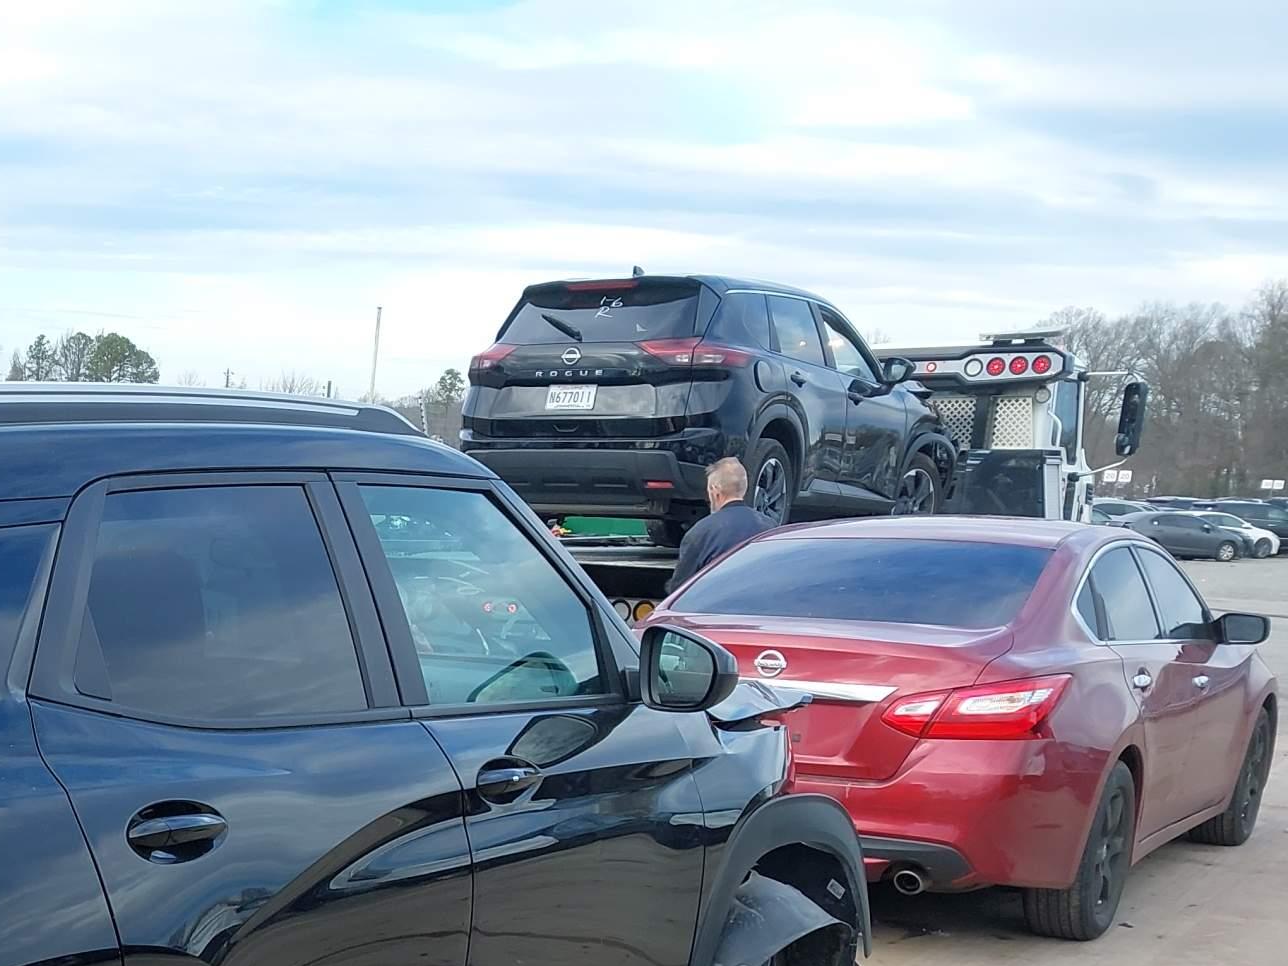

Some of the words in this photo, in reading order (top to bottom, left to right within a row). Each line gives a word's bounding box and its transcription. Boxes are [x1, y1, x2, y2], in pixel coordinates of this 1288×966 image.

[594, 306, 614, 319] R
[535, 369, 604, 378] ROGUE
[548, 391, 592, 404] N677011
